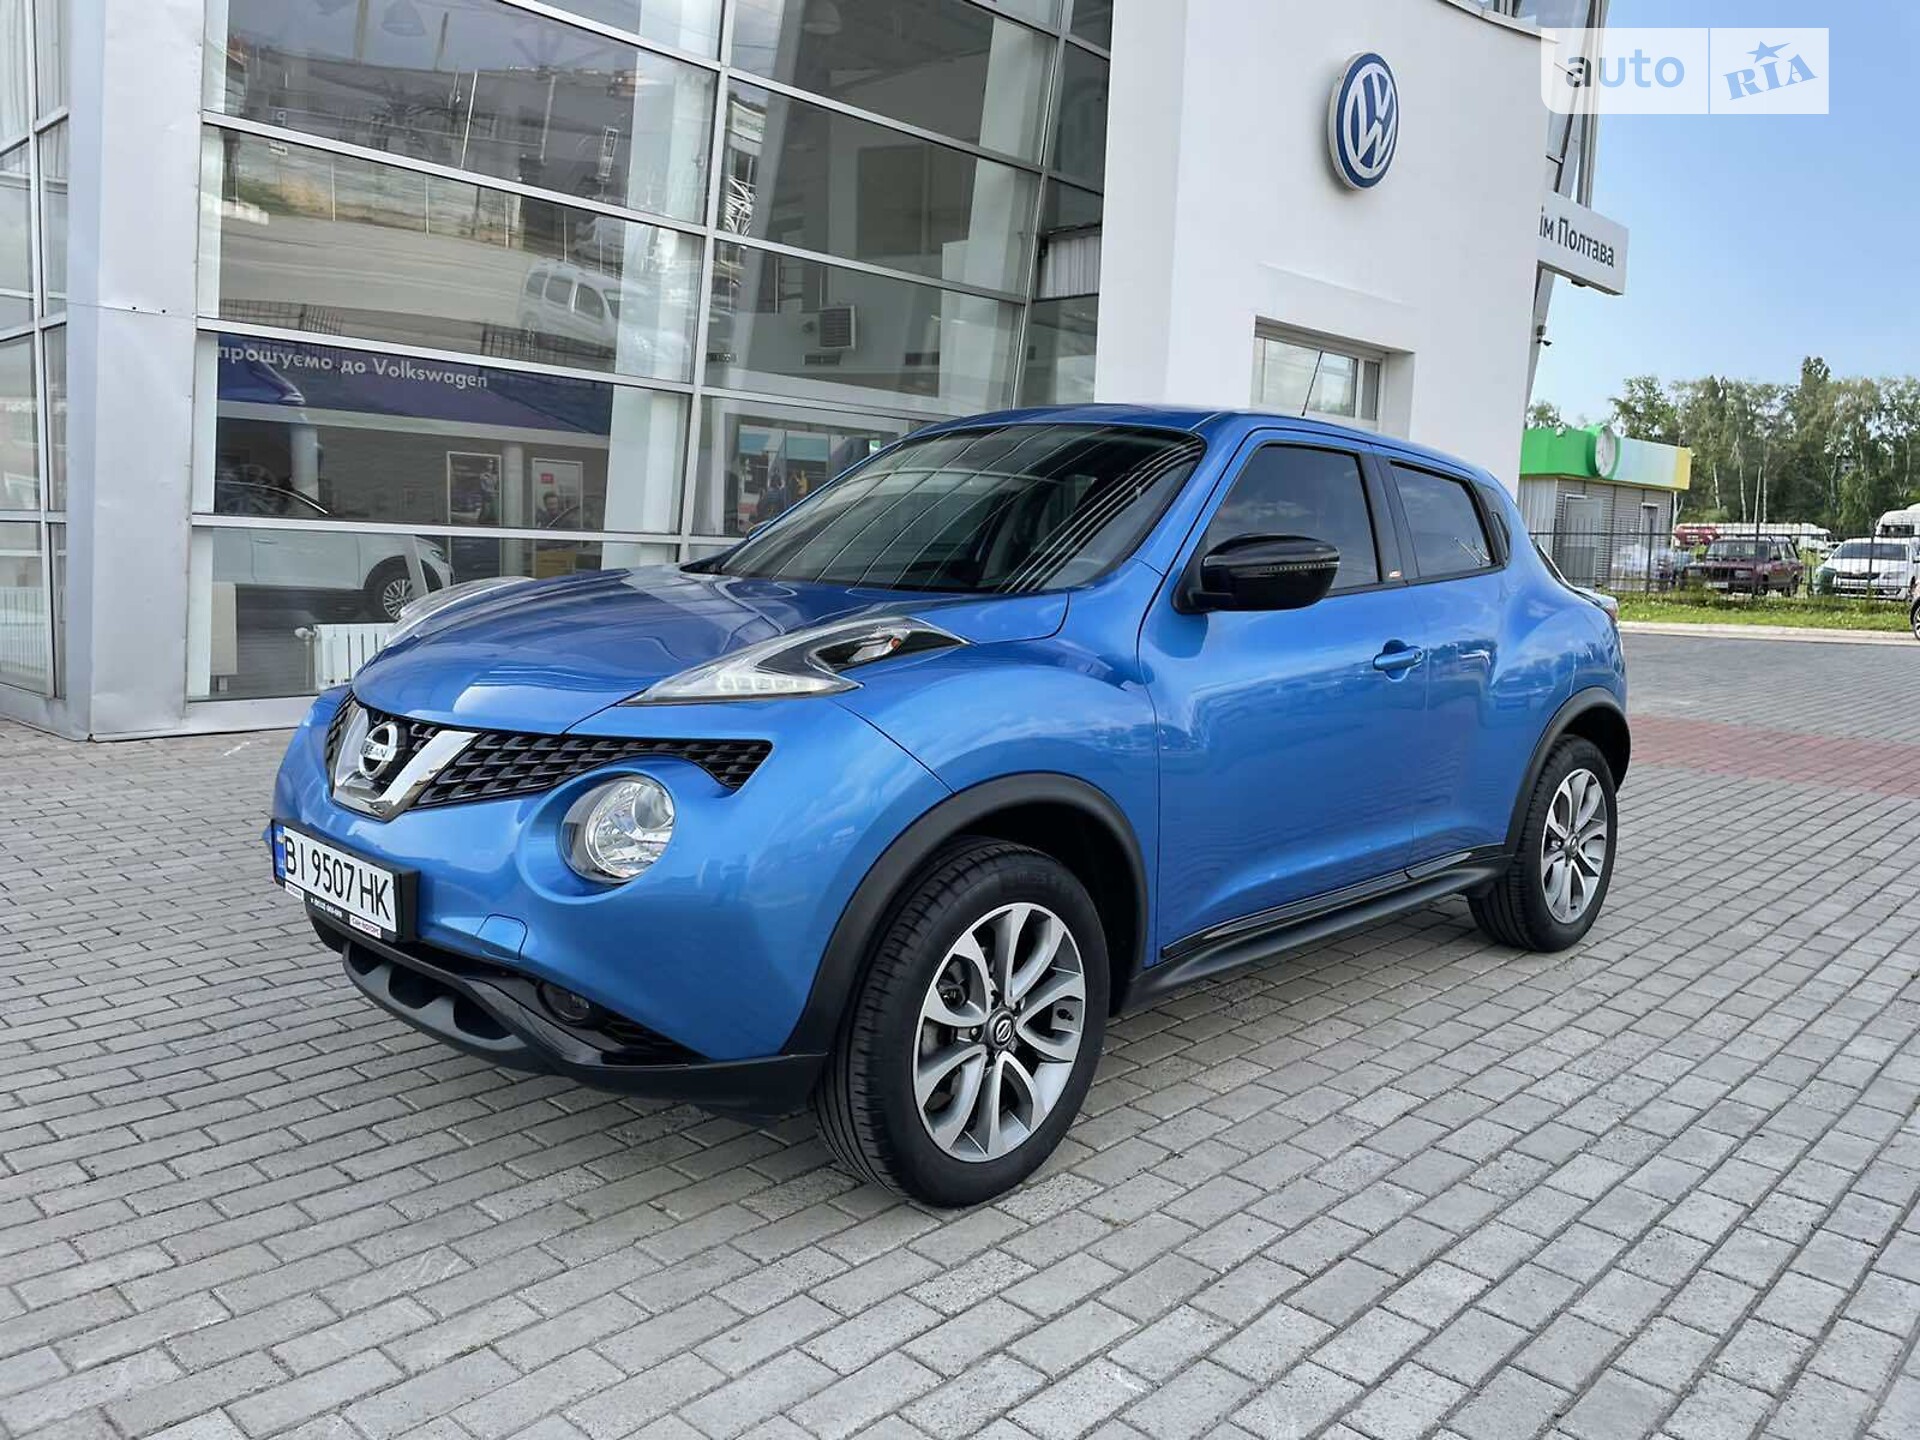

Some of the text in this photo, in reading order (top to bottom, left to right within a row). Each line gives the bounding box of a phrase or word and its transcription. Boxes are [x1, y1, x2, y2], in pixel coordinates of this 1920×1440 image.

[1557, 217, 1615, 268] Полтава
[340, 359, 366, 375] до
[372, 357, 488, 389] Volkswagen
[284, 835, 390, 921] BI 9507 HK
